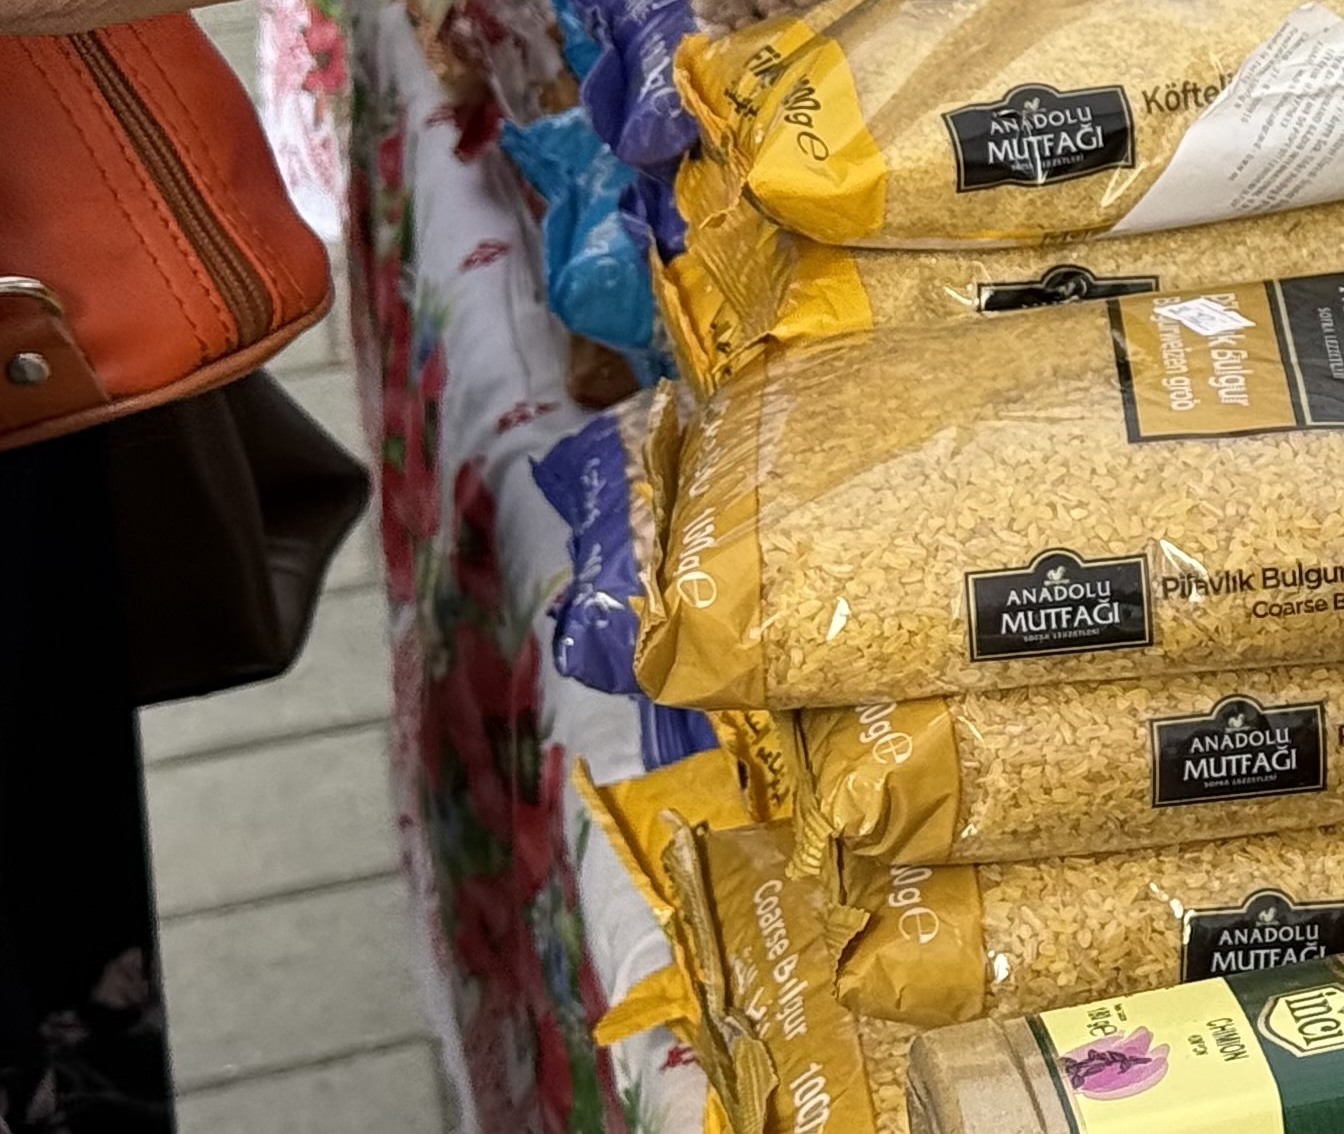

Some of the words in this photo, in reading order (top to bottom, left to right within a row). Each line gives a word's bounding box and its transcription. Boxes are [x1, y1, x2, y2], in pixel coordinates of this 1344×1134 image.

[1142, 74, 1232, 116] Köftel
[989, 104, 1093, 137] ANADOLU
[987, 124, 1104, 166] MUTFAĞI
[1211, 344, 1251, 408] Bulgur
[1162, 377, 1197, 413] grob
[1006, 579, 1112, 608] ANADOLU
[1251, 596, 1329, 620] Coarse
[1000, 599, 1120, 635] MUTFAĞI
[1189, 726, 1291, 755] ANADOLU
[1182, 745, 1298, 782] MUTFAĞI
[752, 879, 795, 963] Coarse
[1218, 922, 1320, 946] ANADOLU
